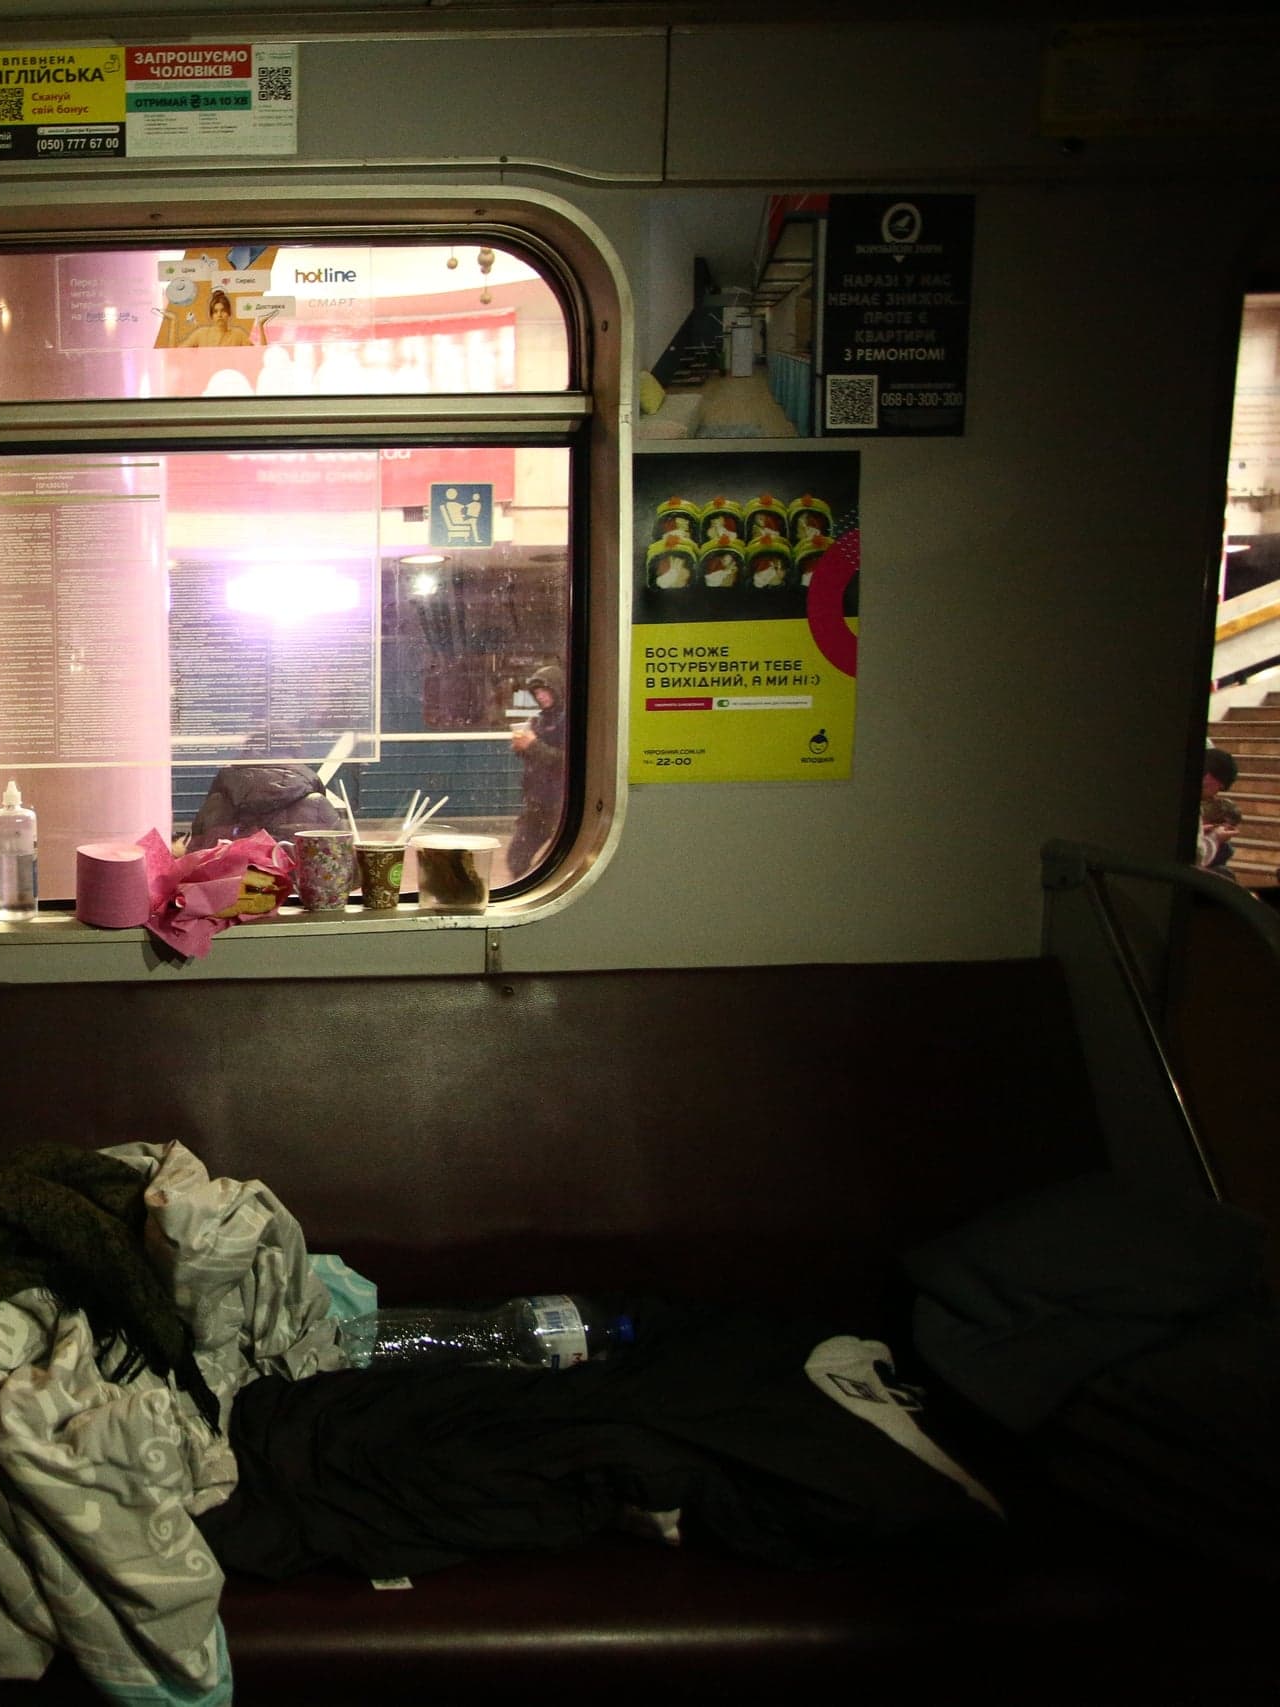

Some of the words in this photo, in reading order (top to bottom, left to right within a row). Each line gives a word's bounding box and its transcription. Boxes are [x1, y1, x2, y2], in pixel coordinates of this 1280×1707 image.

[2, 55, 76, 67] ВПЕВНЕНА
[134, 50, 249, 65] ЗАПРОШУЄМО
[149, 65, 234, 78] ЧОЛОВІКІВ
[31, 92, 71, 104] Скануй
[135, 98, 187, 108] ОТРИМАЙ
[204, 97, 217, 106] ЗА
[219, 97, 232, 106] 10
[31, 105, 54, 116] свій
[56, 104, 89, 116] бонус
[36, 139, 65, 153] (050)
[66, 138, 87, 151] 777
[89, 138, 103, 150] 67
[105, 137, 120, 149] 00
[295, 267, 357, 284] hotline
[856, 347, 945, 362] РЕМОНТОМ!
[645, 646, 678, 659] БОС
[683, 646, 729, 658] МОЖЕ
[645, 660, 760, 674] ПОТУРБУВАТИ
[764, 659, 803, 672] ТЕБЕ
[645, 677, 656, 689] В
[660, 674, 748, 690] ВИХІДНИЙ,
[766, 675, 789, 686] МИ
[656, 757, 692, 767] 22-00
